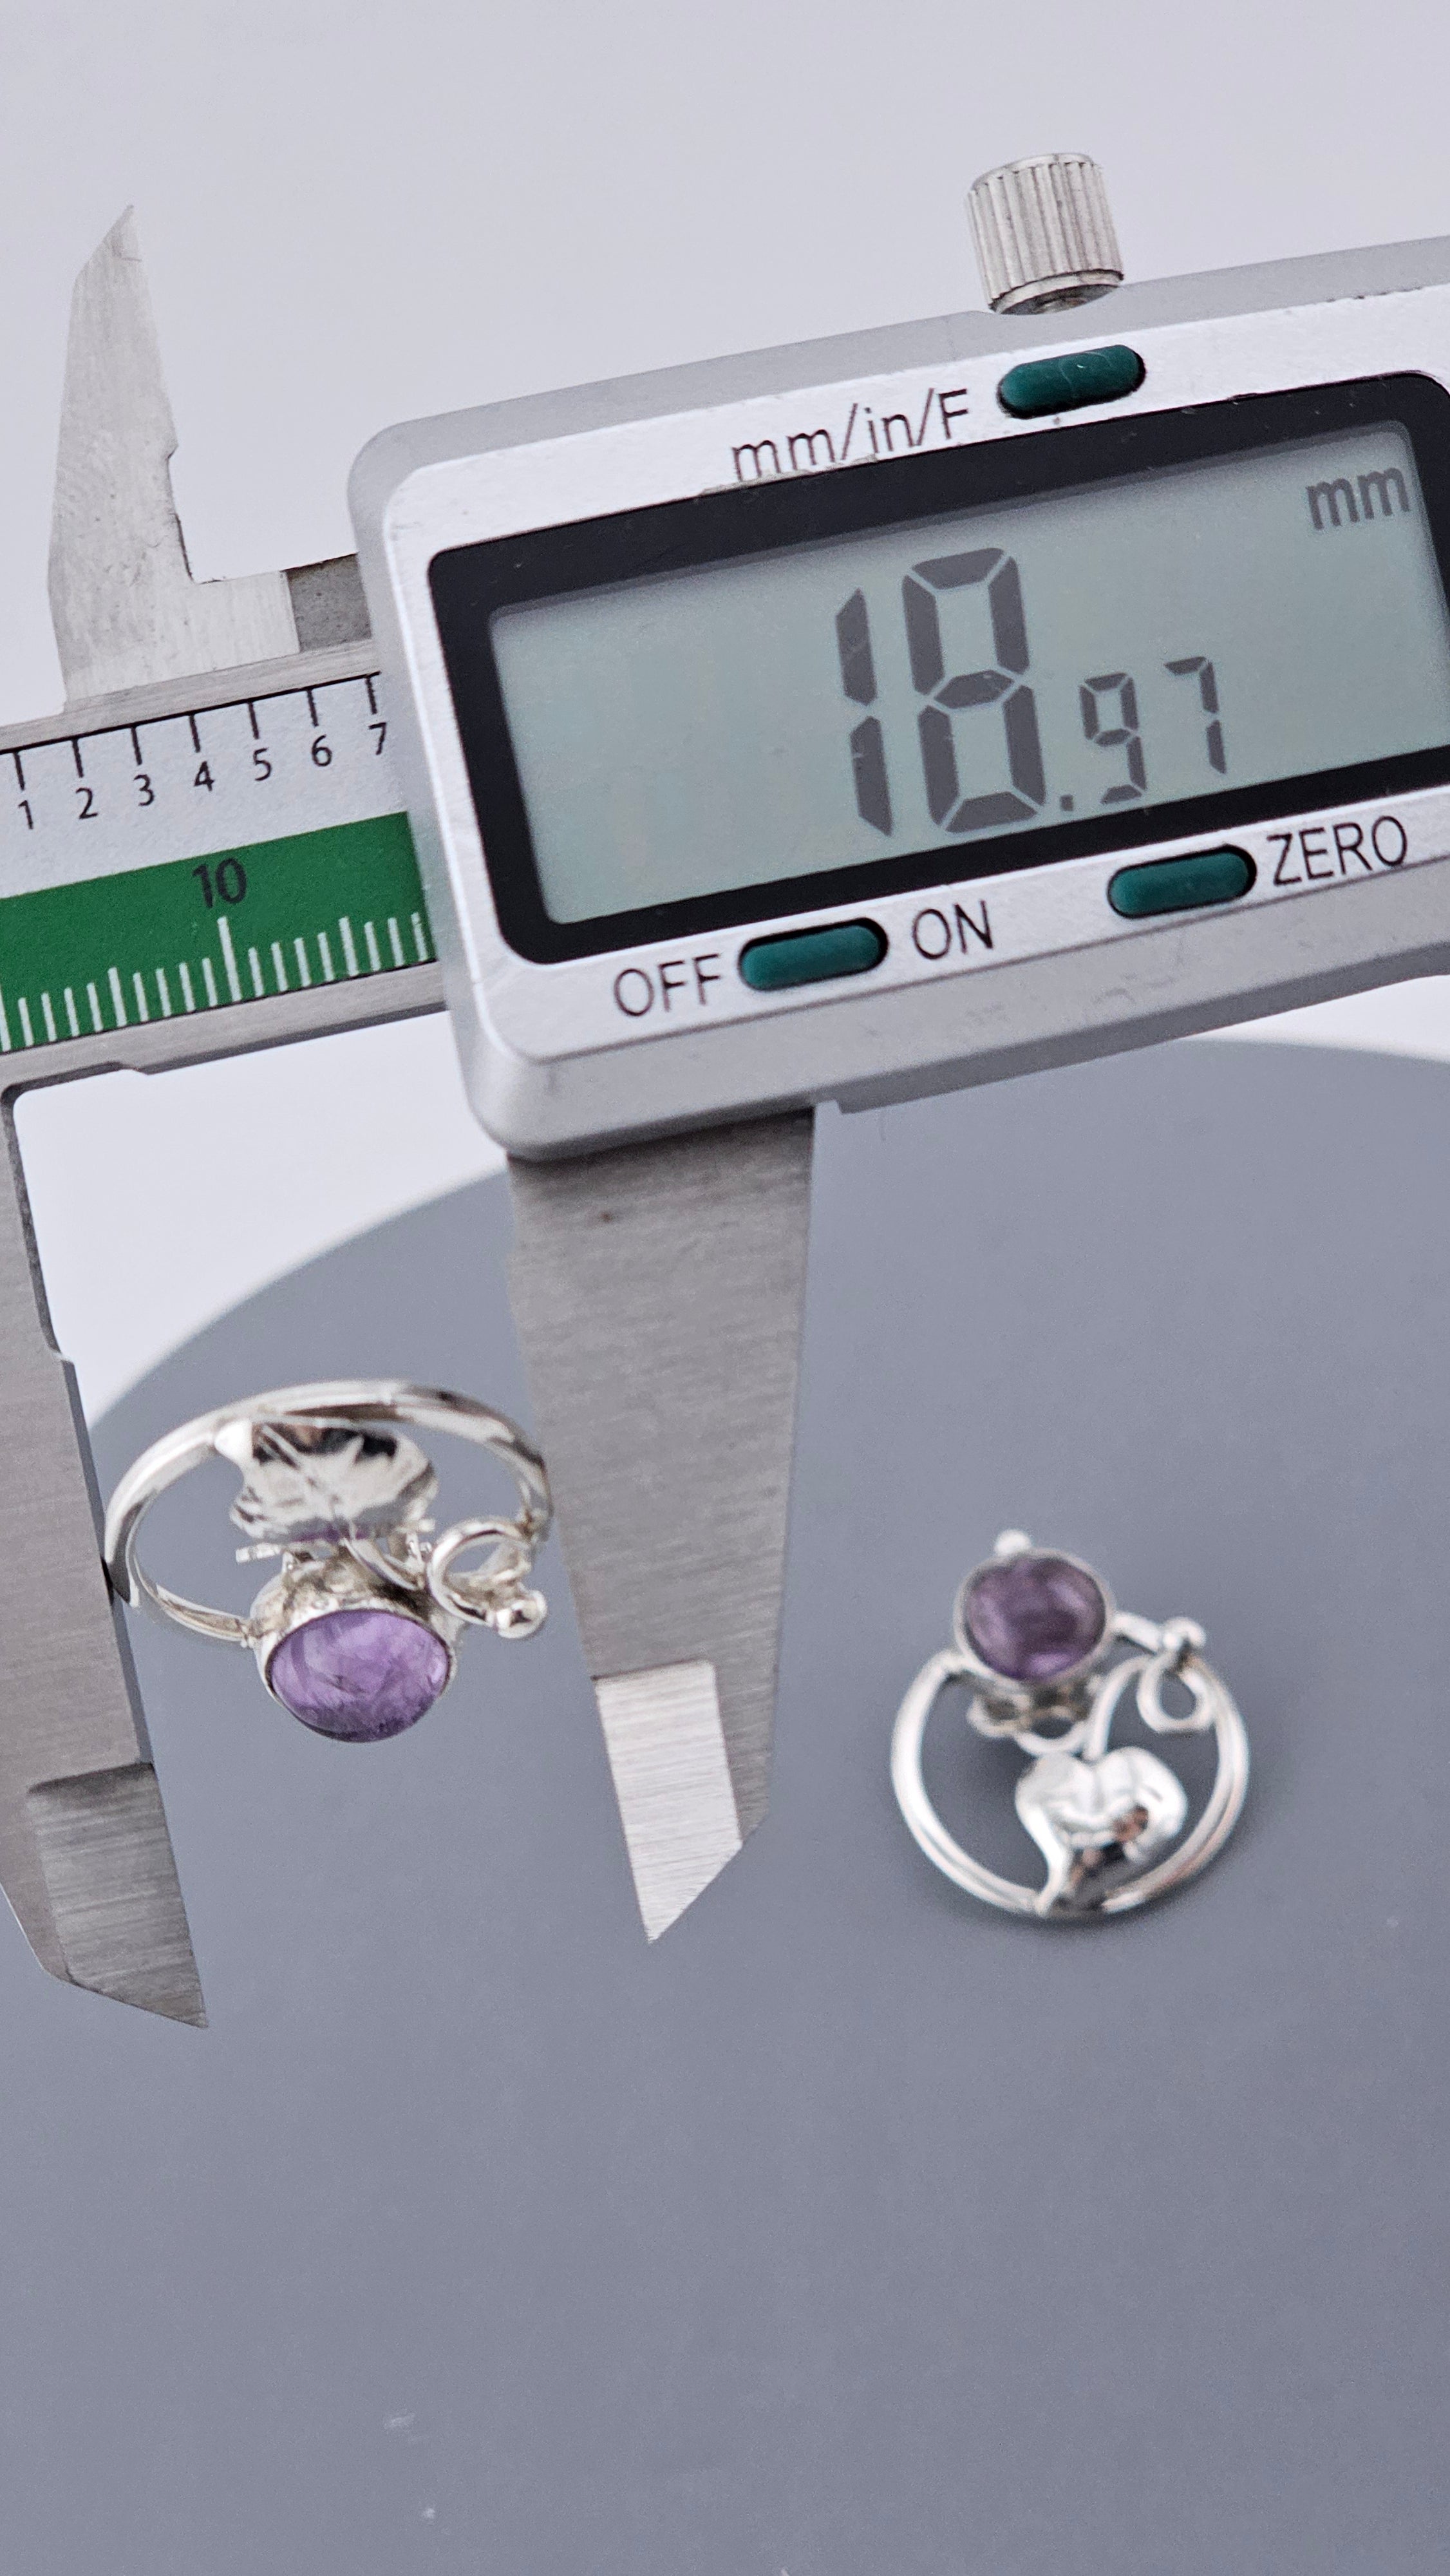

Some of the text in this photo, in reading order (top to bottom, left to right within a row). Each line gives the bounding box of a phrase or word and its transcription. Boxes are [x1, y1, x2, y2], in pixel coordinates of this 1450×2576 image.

[731, 388, 970, 482] mm/in/F
[1305, 466, 1411, 531] mm
[834, 547, 1227, 837] 18.97
[17, 721, 388, 830] 1 2 3 4 5 6 7
[193, 857, 248, 909] 10
[1265, 814, 1409, 887] ZERO
[613, 900, 995, 1018] OFF ON
